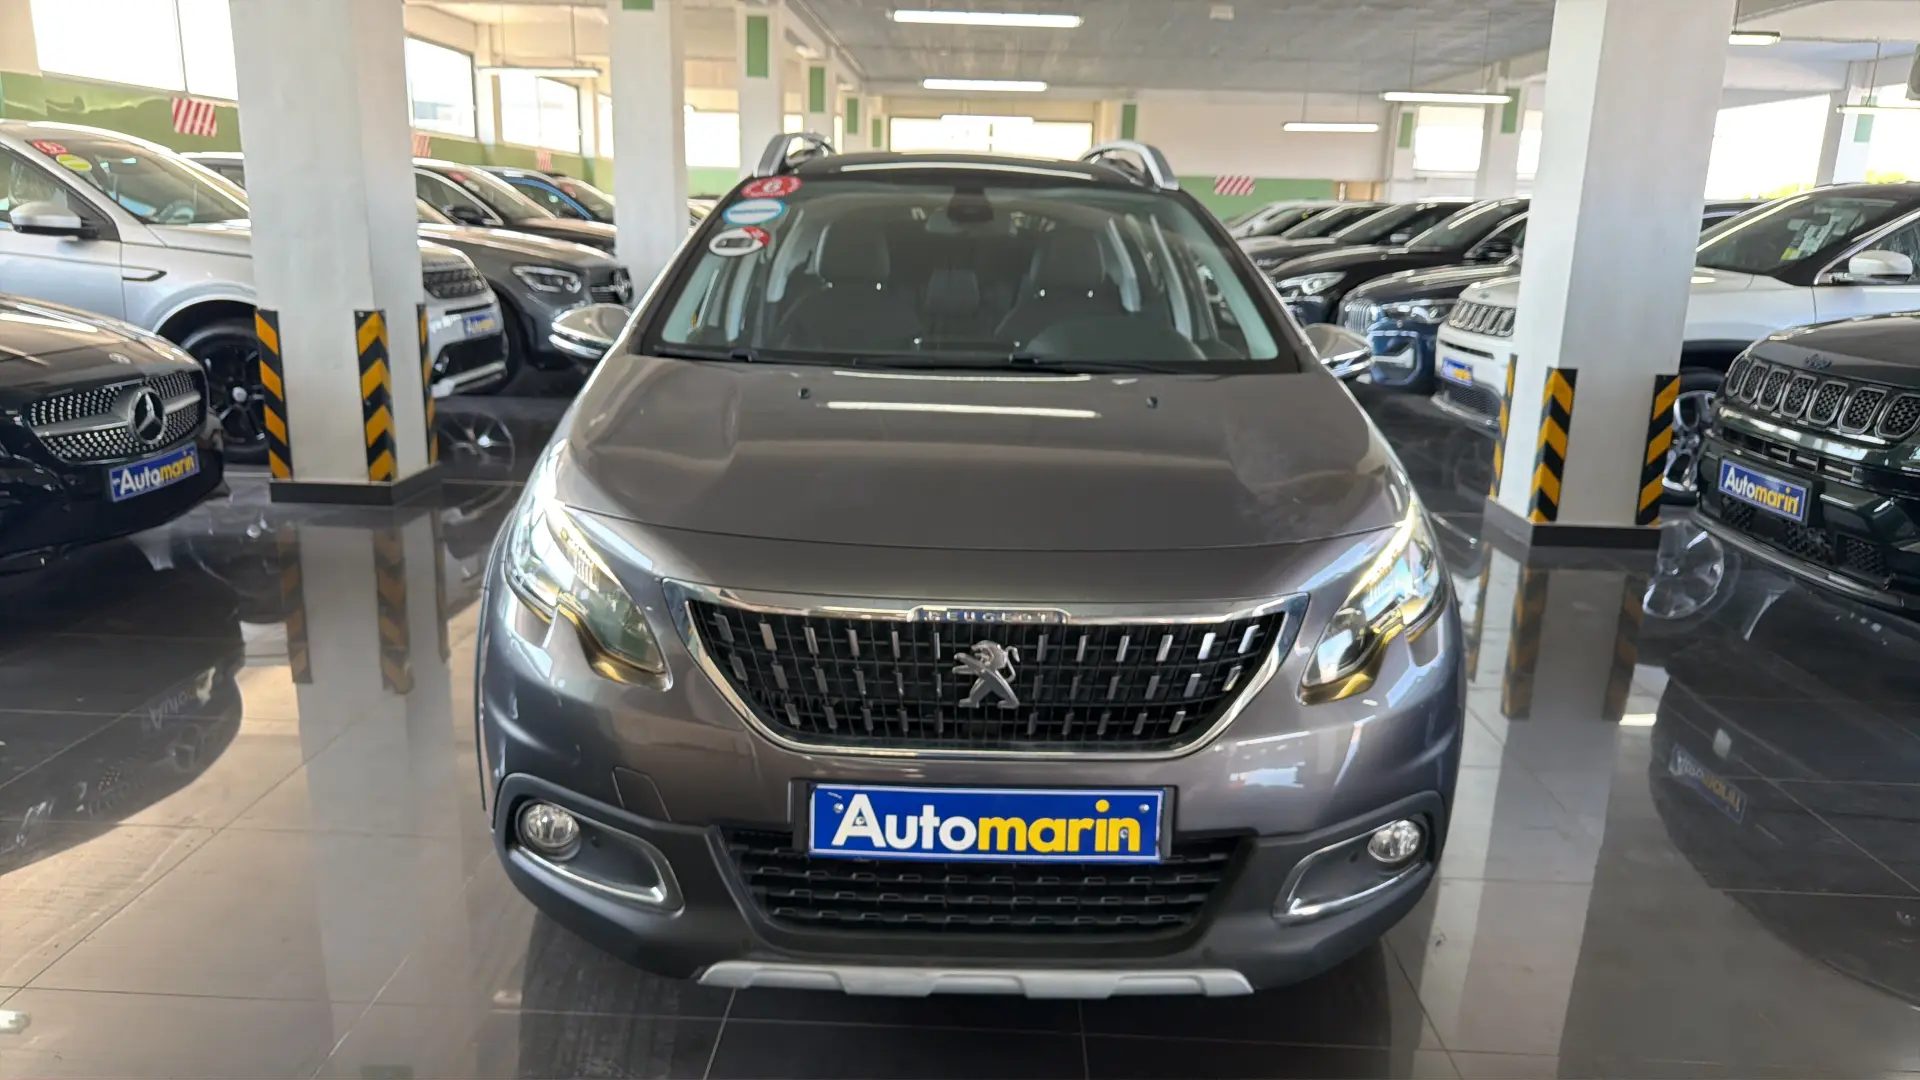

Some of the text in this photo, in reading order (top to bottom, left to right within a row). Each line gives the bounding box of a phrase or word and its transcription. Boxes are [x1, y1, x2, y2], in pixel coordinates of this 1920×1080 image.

[120, 450, 196, 495] Automarin
[1724, 465, 1800, 516] Automarin
[831, 793, 1141, 853] Automarin
